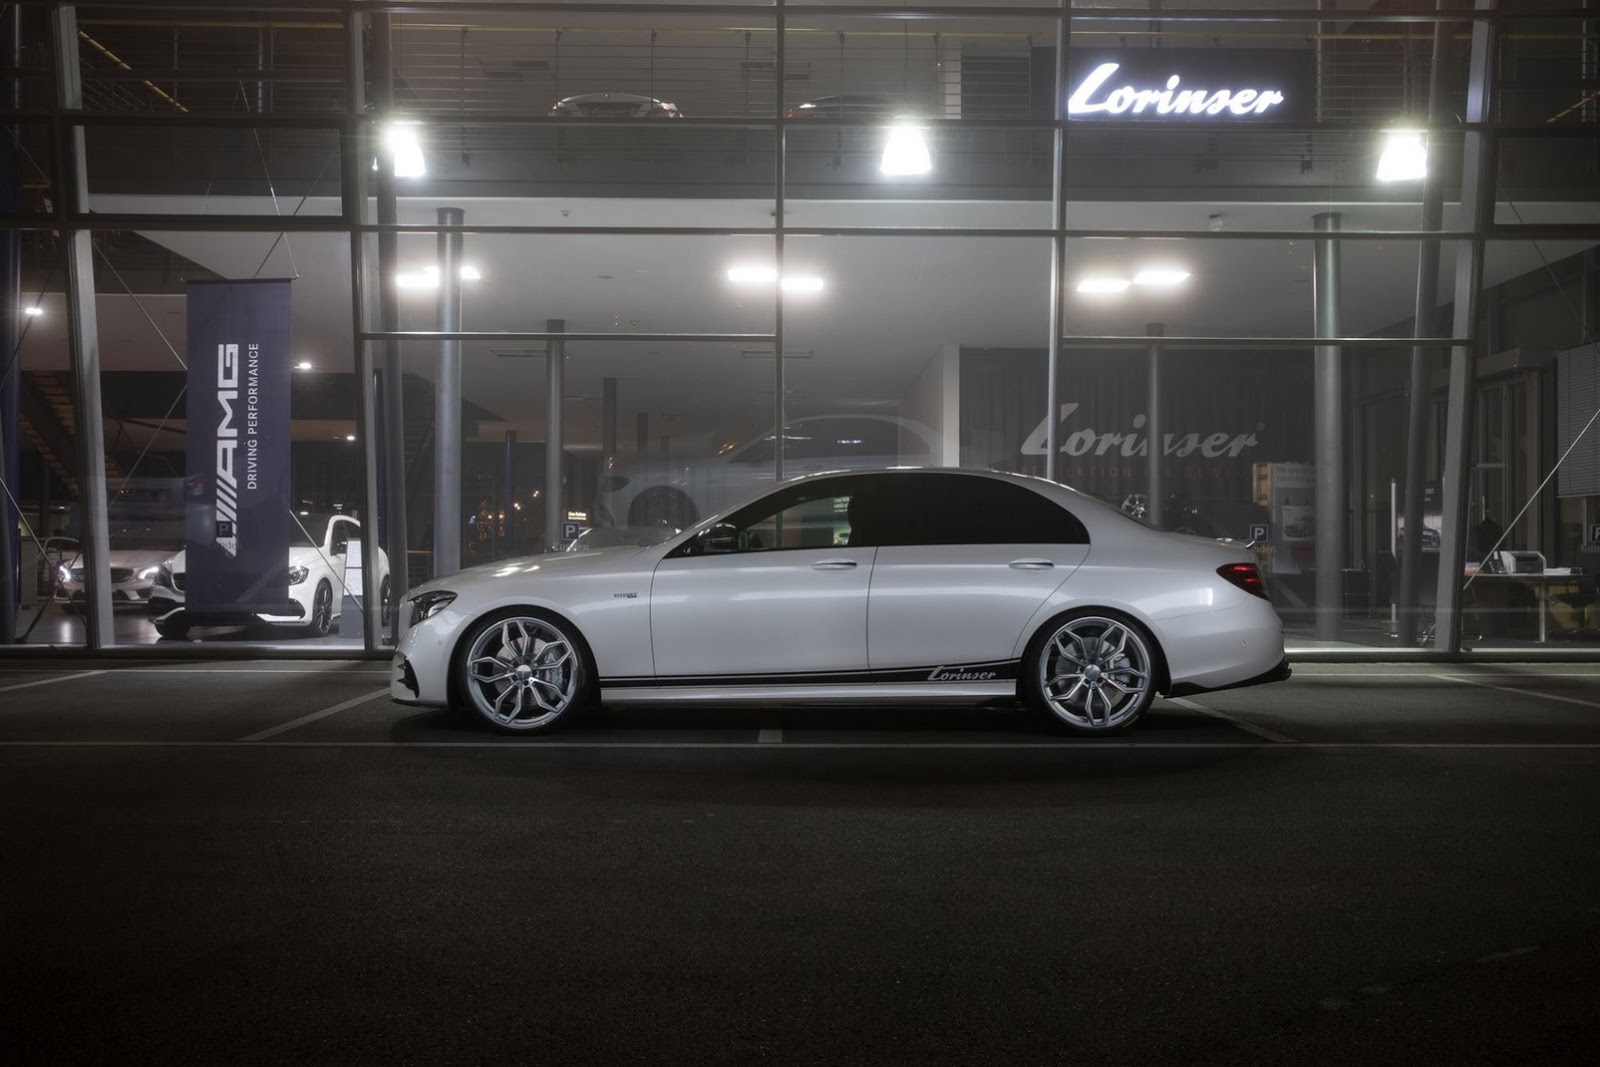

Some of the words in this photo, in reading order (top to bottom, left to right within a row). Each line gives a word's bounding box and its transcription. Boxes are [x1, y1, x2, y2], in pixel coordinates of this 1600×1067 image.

[1068, 62, 1284, 115] Lorinser
[247, 343, 259, 435] PERFORMANCE
[217, 344, 239, 489] AMG
[247, 439, 258, 490] DRIVING
[565, 525, 576, 538] P
[1254, 527, 1265, 540] P
[927, 665, 996, 681] Lorinser
